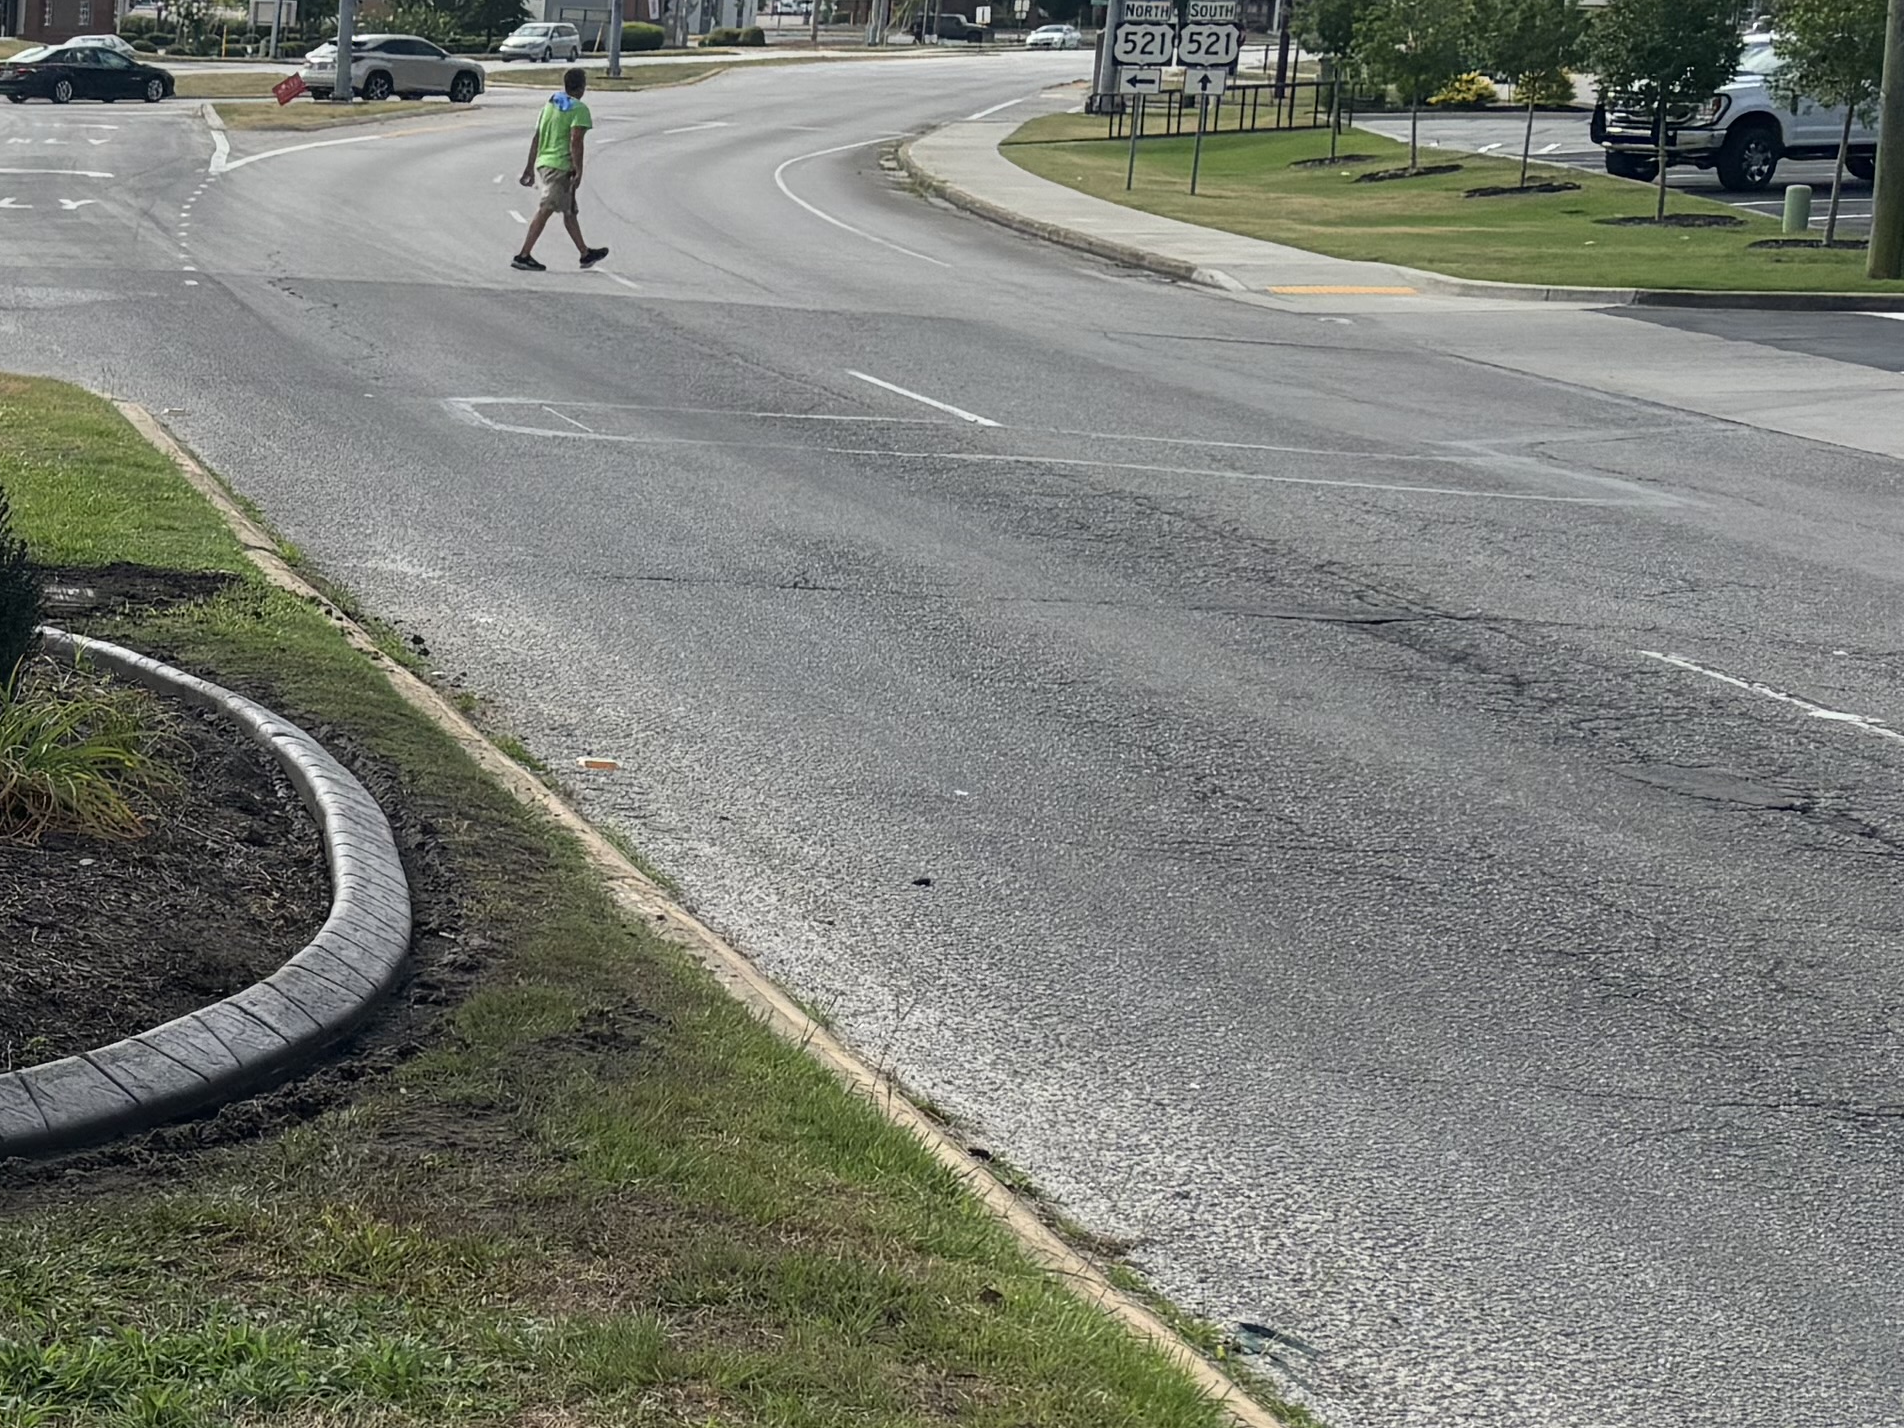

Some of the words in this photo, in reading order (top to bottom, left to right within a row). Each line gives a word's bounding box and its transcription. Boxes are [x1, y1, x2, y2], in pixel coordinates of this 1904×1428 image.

[1125, 4, 1169, 18] NORTH
[1191, 4, 1234, 18] SOUTH
[1123, 32, 1166, 55] 521
[1187, 32, 1231, 55] 521
